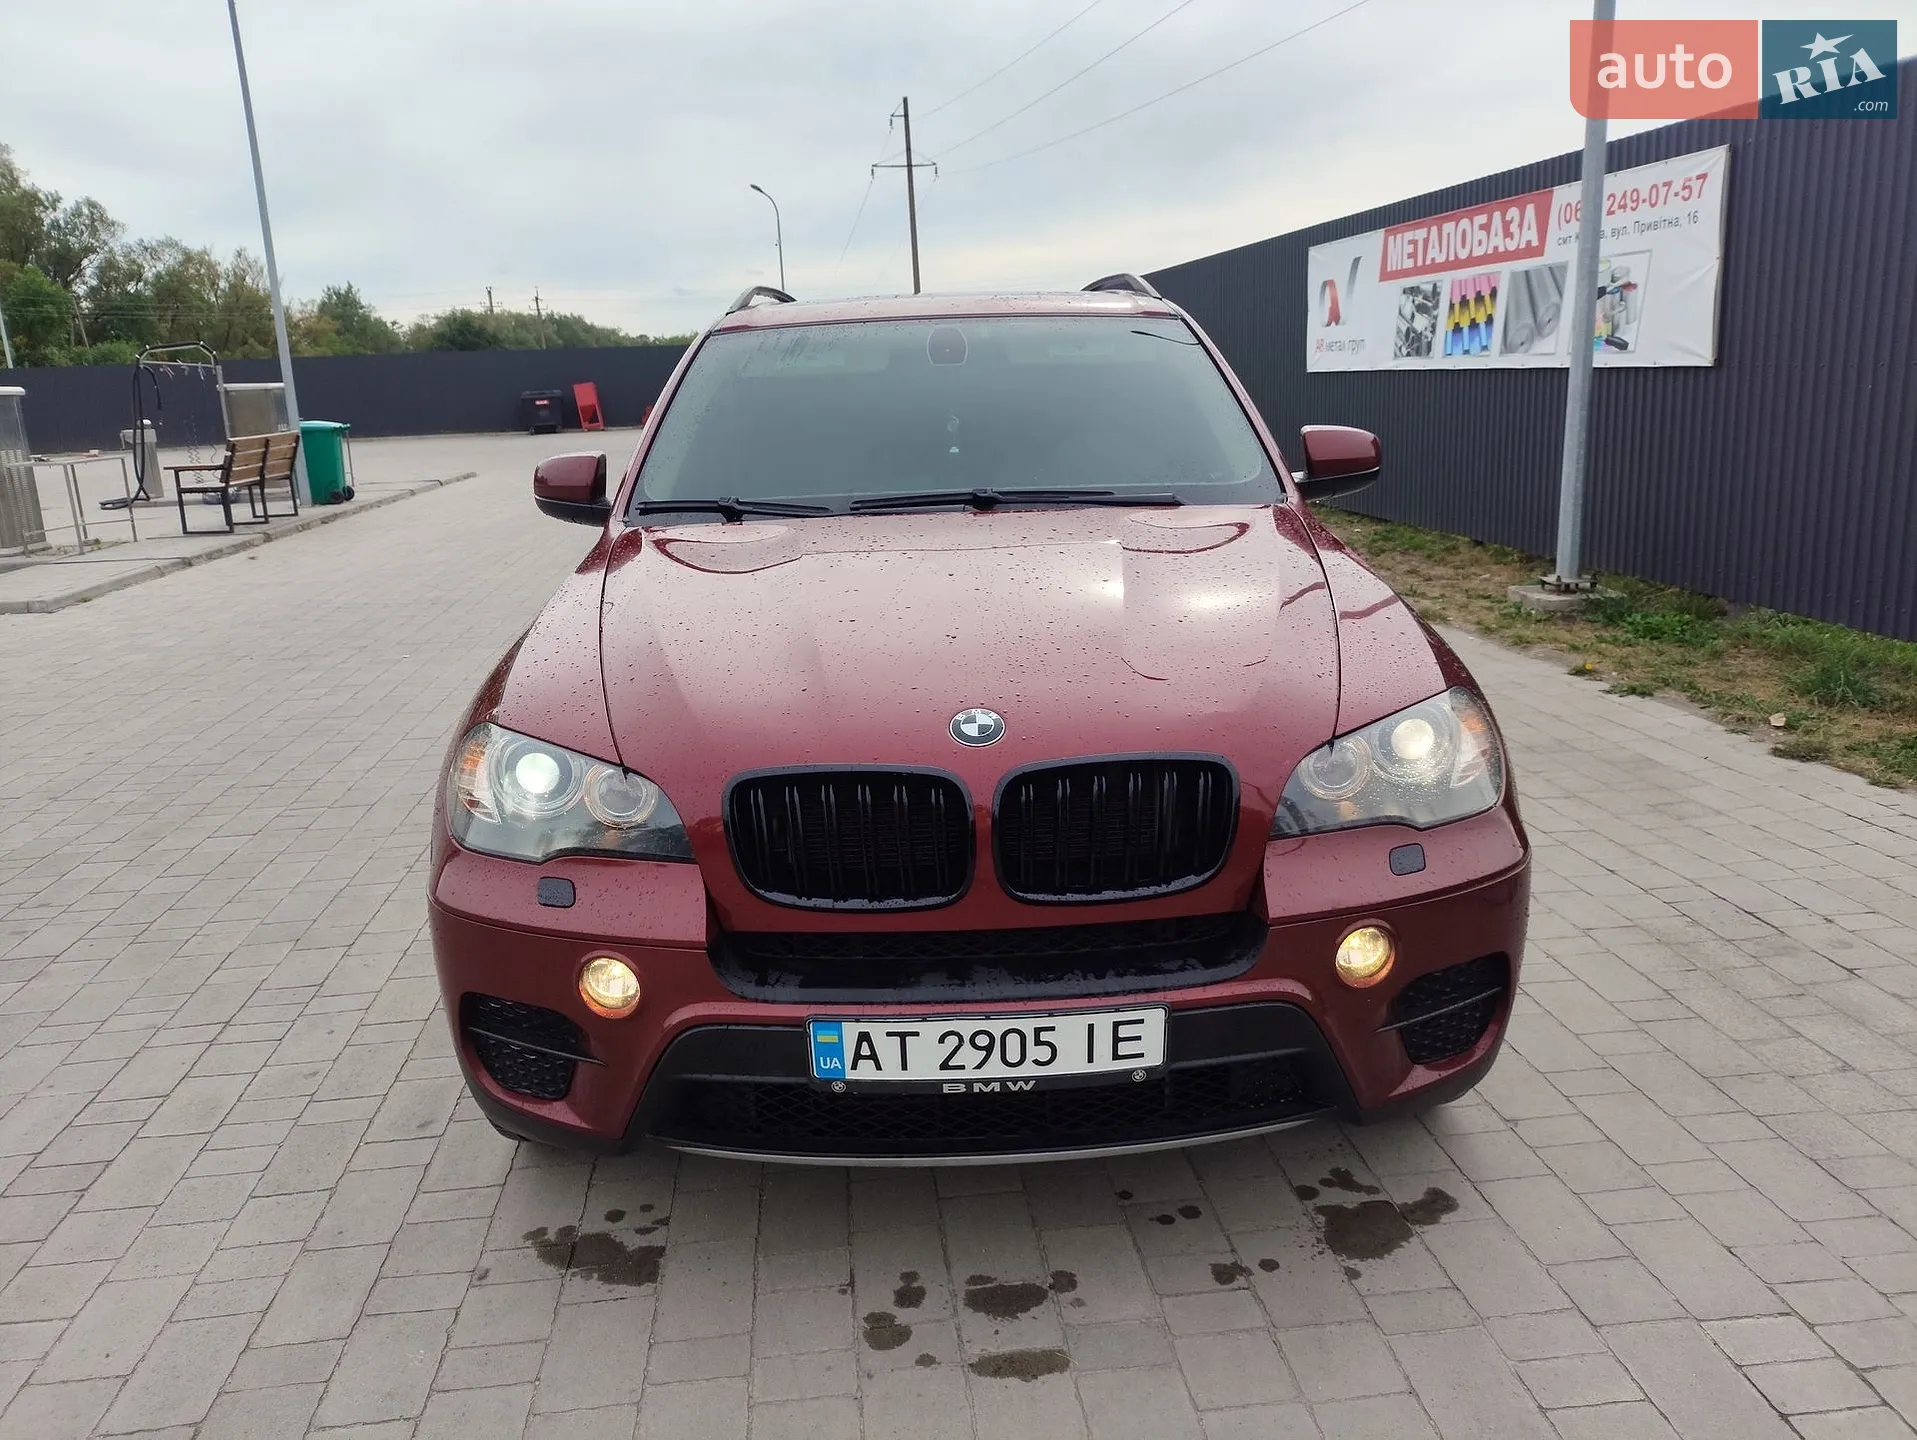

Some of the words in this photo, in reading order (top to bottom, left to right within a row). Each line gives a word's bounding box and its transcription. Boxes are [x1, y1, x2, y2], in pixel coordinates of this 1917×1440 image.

[1605, 172, 1709, 217] 249-07-57
[1386, 203, 1540, 273] МЕТАЛОБАЗА
[1557, 234, 1572, 247] смт
[1610, 226, 1630, 241] вул.
[1686, 210, 1700, 226] 16
[820, 1055, 842, 1070] UA
[850, 1030, 920, 1072] AT
[937, 1025, 1058, 1071] 2905
[1086, 1018, 1145, 1064] IE
[942, 1080, 1036, 1094] BMW
